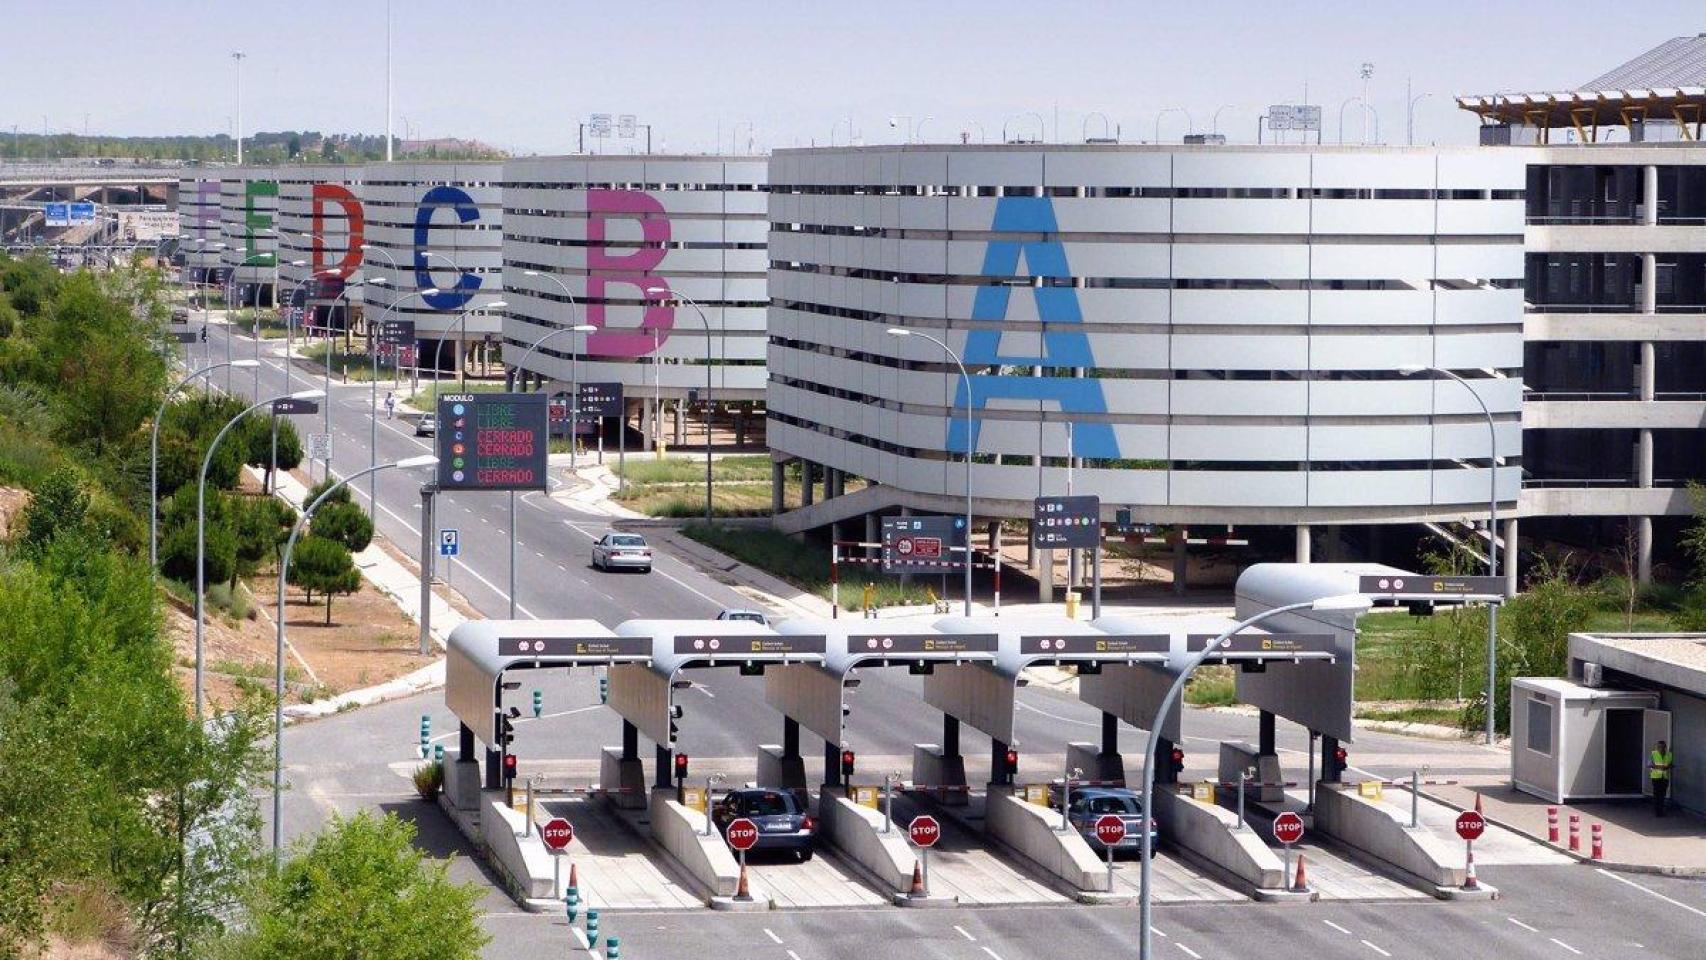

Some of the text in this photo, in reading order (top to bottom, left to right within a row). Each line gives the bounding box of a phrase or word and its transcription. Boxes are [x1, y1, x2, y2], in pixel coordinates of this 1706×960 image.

[246, 180, 280, 267] E
[313, 184, 364, 282] D
[414, 185, 482, 310] C
[586, 190, 674, 357] B
[945, 195, 1122, 459] A
[477, 430, 533, 442] CERRADO
[477, 443, 533, 456] CERRADO
[477, 470, 533, 482] CERRADO
[912, 826, 936, 835] STOP
[1099, 825, 1123, 834] STOP
[1277, 823, 1301, 832] STOP
[1458, 821, 1483, 830] STOP
[546, 829, 571, 838] STOP
[730, 829, 755, 838] STOP
